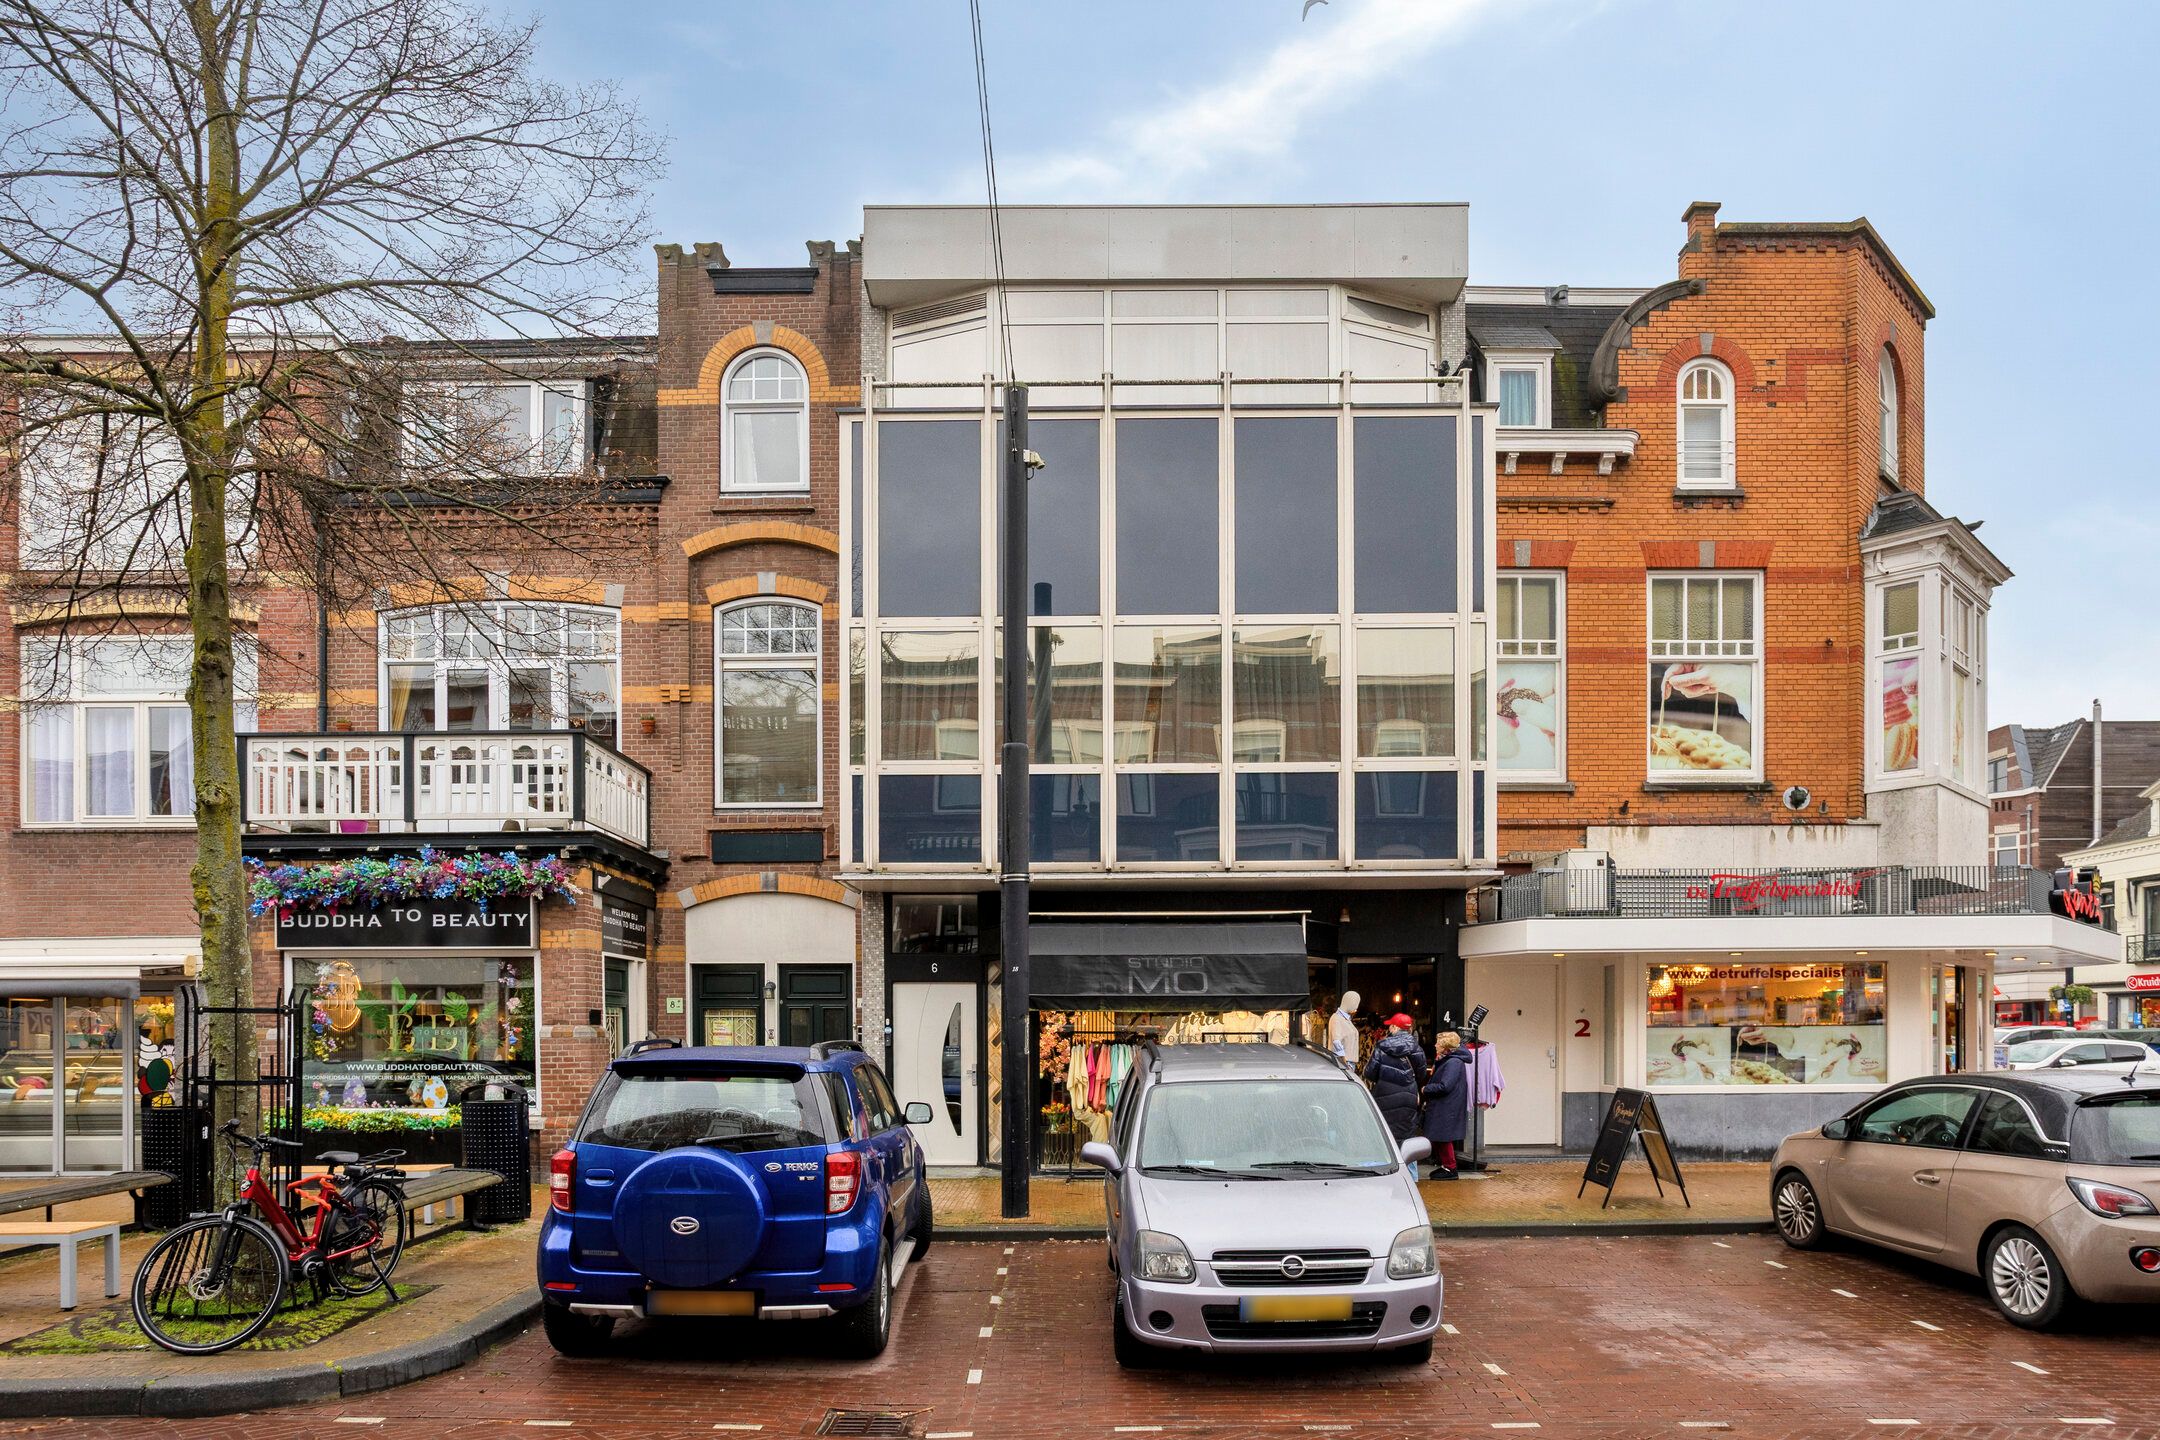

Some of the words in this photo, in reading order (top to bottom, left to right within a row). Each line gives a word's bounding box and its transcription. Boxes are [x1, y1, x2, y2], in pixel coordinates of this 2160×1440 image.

[1687, 886, 1708, 899] De
[1710, 874, 1862, 902] Truffelspecialist
[280, 914, 382, 928] BUDDHA
[391, 908, 422, 922] TO
[432, 913, 529, 927] BEAUTY
[931, 962, 938, 973] 6
[1128, 957, 1204, 969] STUDIO
[1128, 971, 1208, 994] MO
[2138, 976, 2160, 988] Kruid
[1443, 1010, 1451, 1023] 4
[1574, 1018, 1591, 1037] 2
[346, 1063, 486, 1071] WWW.BUDDHATOBEAUTY.NL
[784, 1162, 819, 1171] TERIOS
